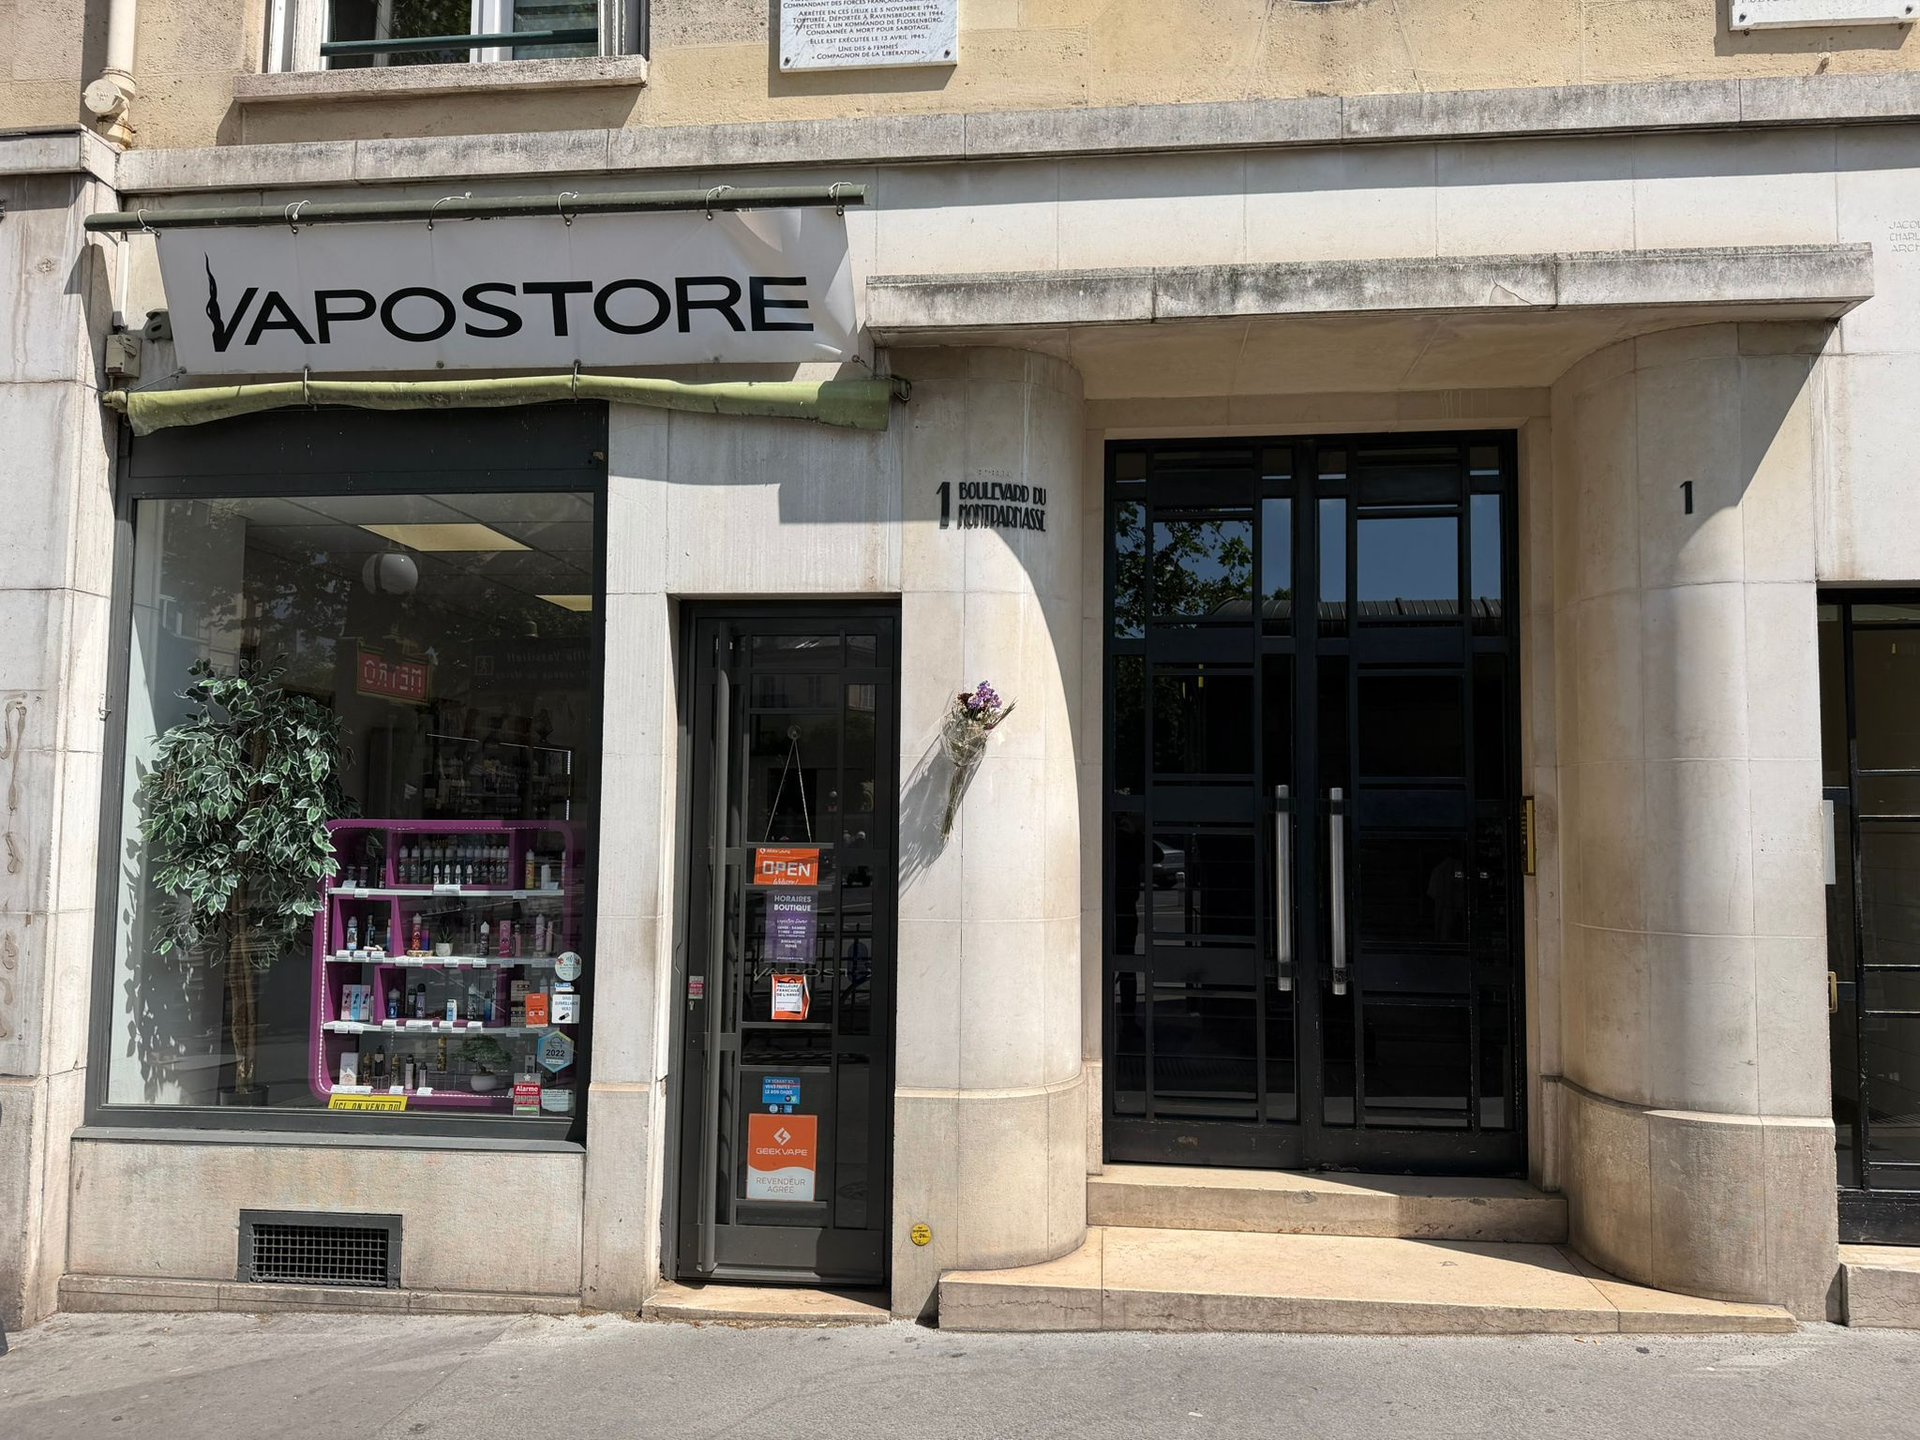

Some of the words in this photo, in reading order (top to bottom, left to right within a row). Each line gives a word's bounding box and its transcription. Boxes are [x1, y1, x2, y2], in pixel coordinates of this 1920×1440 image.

[204, 253, 814, 352] VAPOSTORE
[936, 482, 950, 529] 1
[959, 482, 1030, 503] BOULEVARD
[1033, 487, 1046, 506] DU
[1680, 481, 1693, 515] 1
[957, 504, 1046, 532] MONTPARNASSE
[762, 860, 811, 877] OPEN
[774, 895, 812, 903] HORAIRES
[774, 904, 812, 912] BOUTIQUE
[545, 1049, 565, 1057] 2022
[756, 1177, 806, 1186] REVENDEUR
